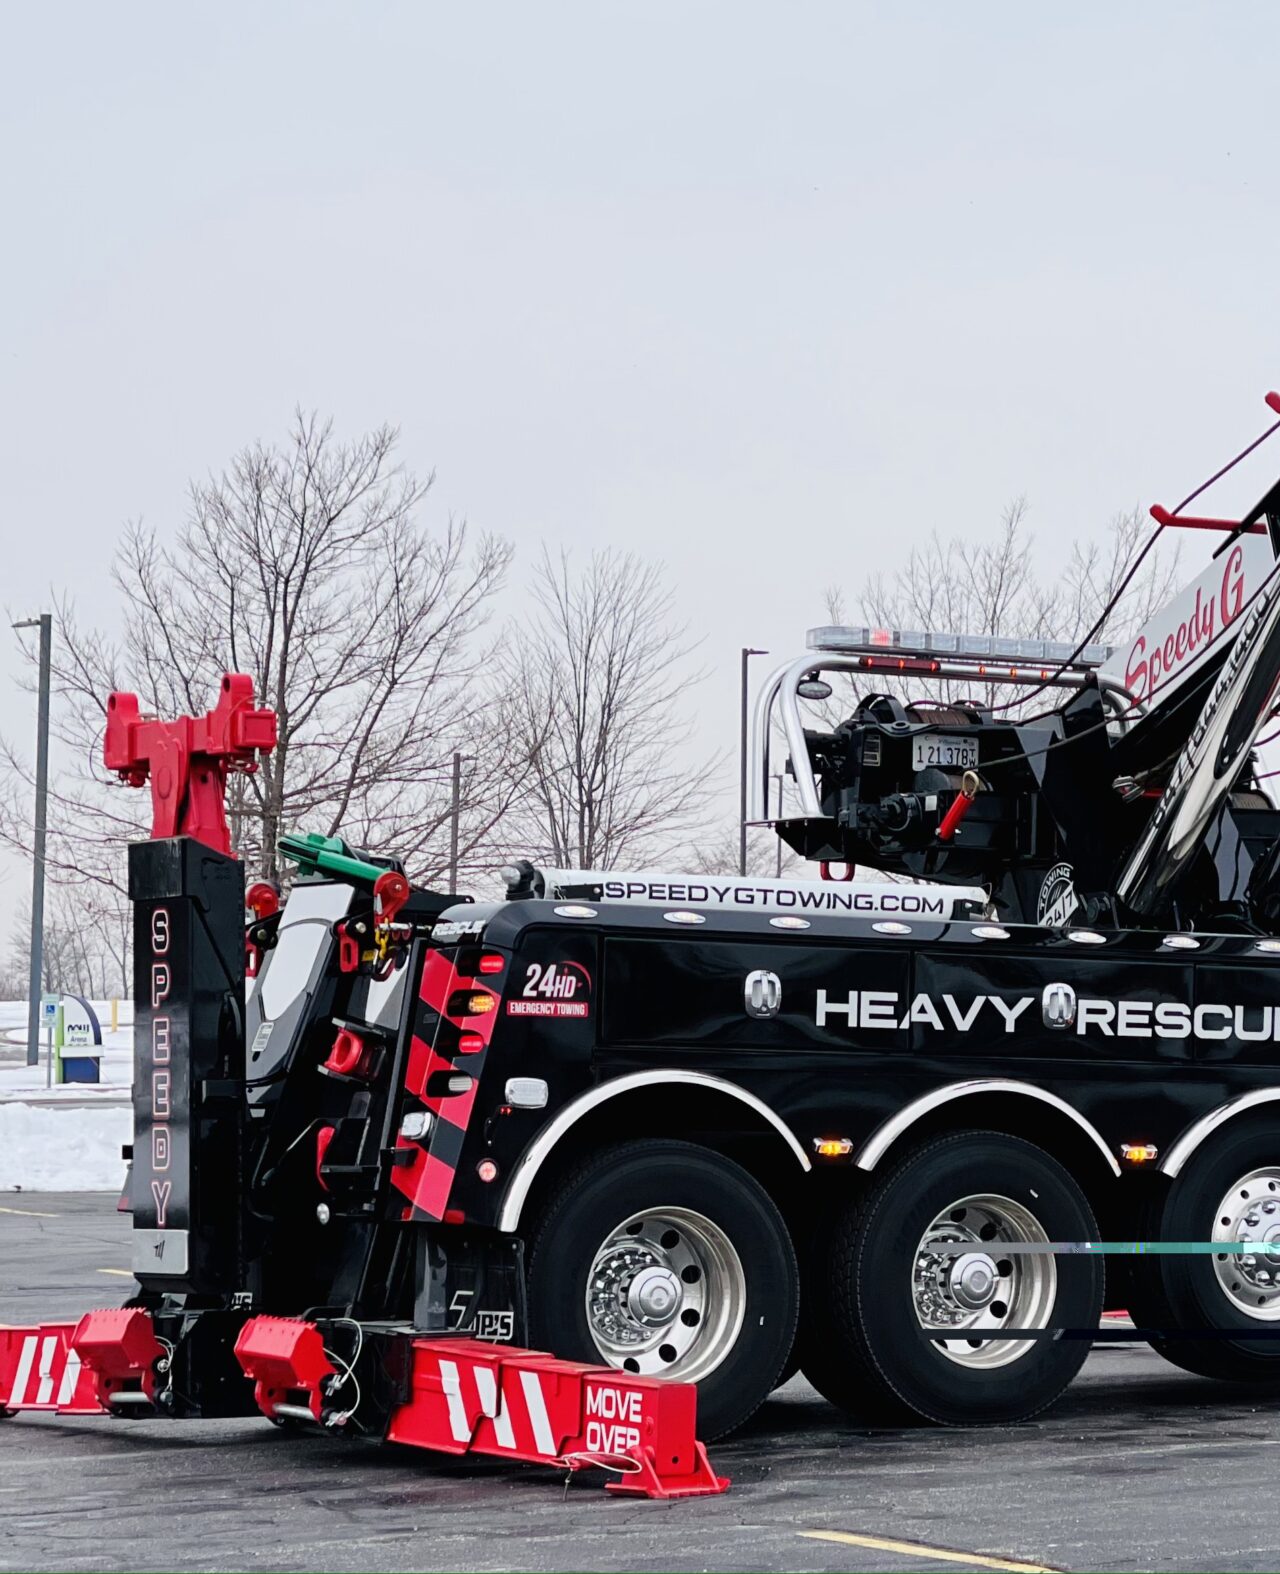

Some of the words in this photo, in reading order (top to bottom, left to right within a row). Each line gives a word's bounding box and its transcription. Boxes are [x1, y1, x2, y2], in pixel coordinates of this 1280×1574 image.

[1125, 586, 1215, 707] Speedy
[1220, 545, 1245, 628] G
[604, 881, 944, 915] SPEEDYGTOWING.COM
[1040, 866, 1071, 911] TOWING
[432, 919, 486, 936] RESCUE
[510, 1001, 555, 1014] EMERGENCY
[557, 1003, 585, 1016] TOWING
[815, 989, 1035, 1033] HEAVY
[151, 908, 172, 1226] SPEEDY
[586, 1385, 643, 1423] MOVE
[586, 1421, 641, 1454] OVER
